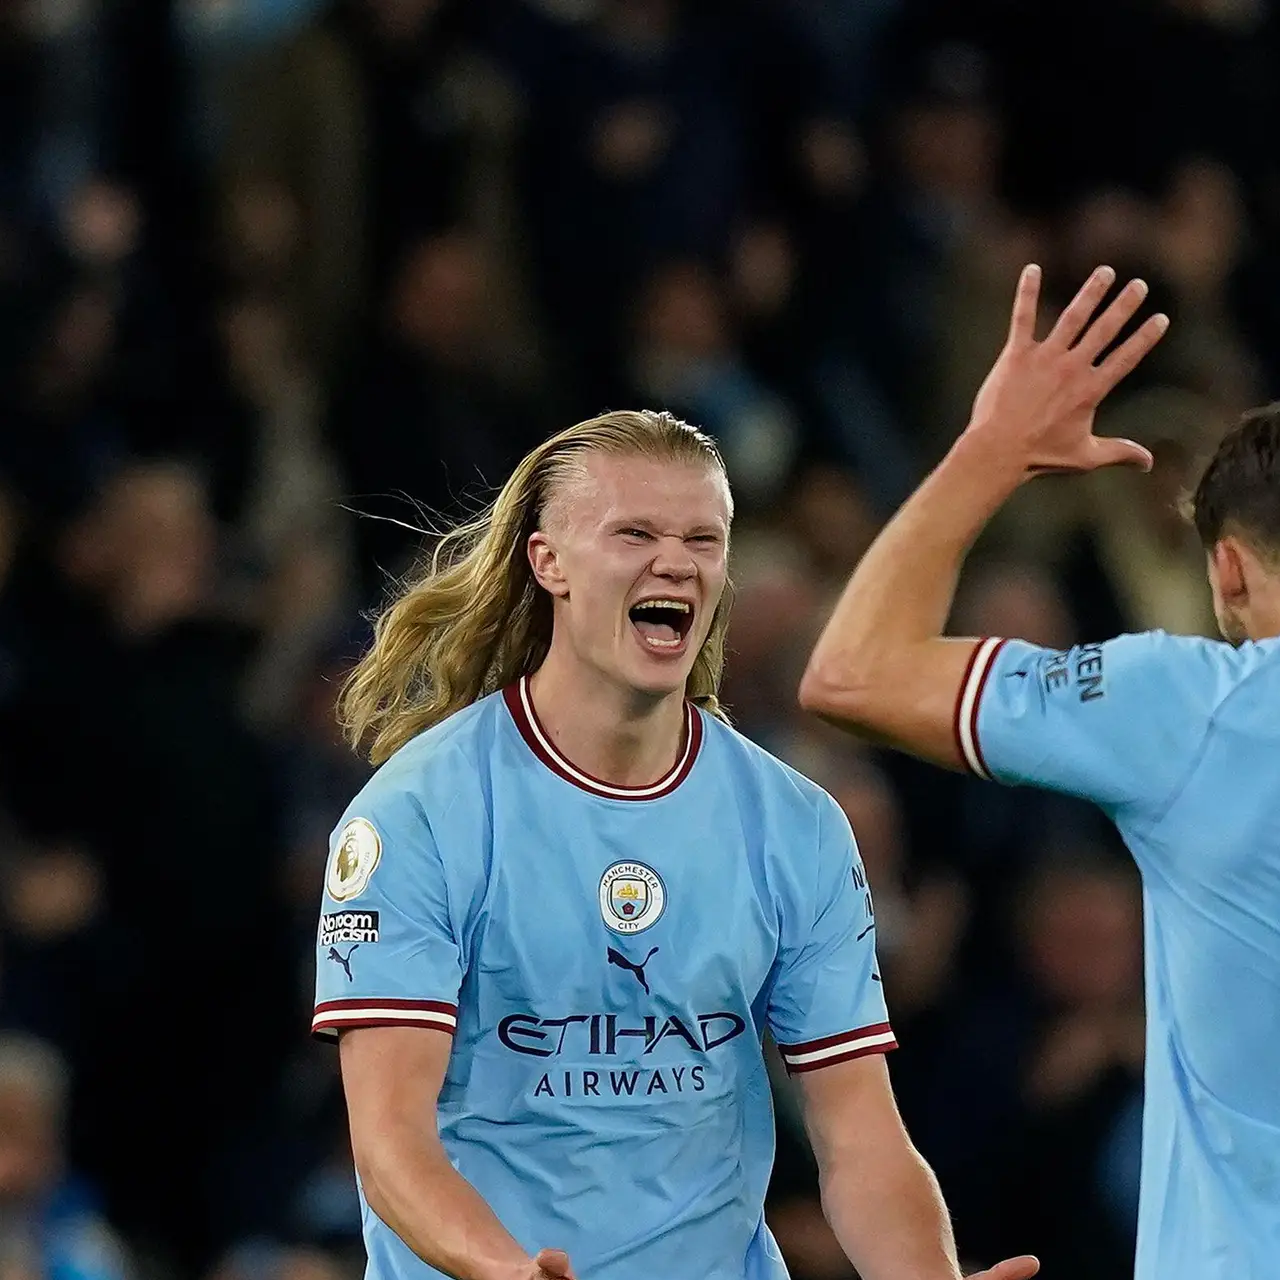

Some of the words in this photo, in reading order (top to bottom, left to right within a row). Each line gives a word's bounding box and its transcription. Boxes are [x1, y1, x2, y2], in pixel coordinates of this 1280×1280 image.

[603, 865, 659, 889] MANCHESTER
[617, 922, 640, 930] CITY
[497, 1011, 746, 1058] ETIHAD
[534, 1065, 705, 1098] AIRWAYS
